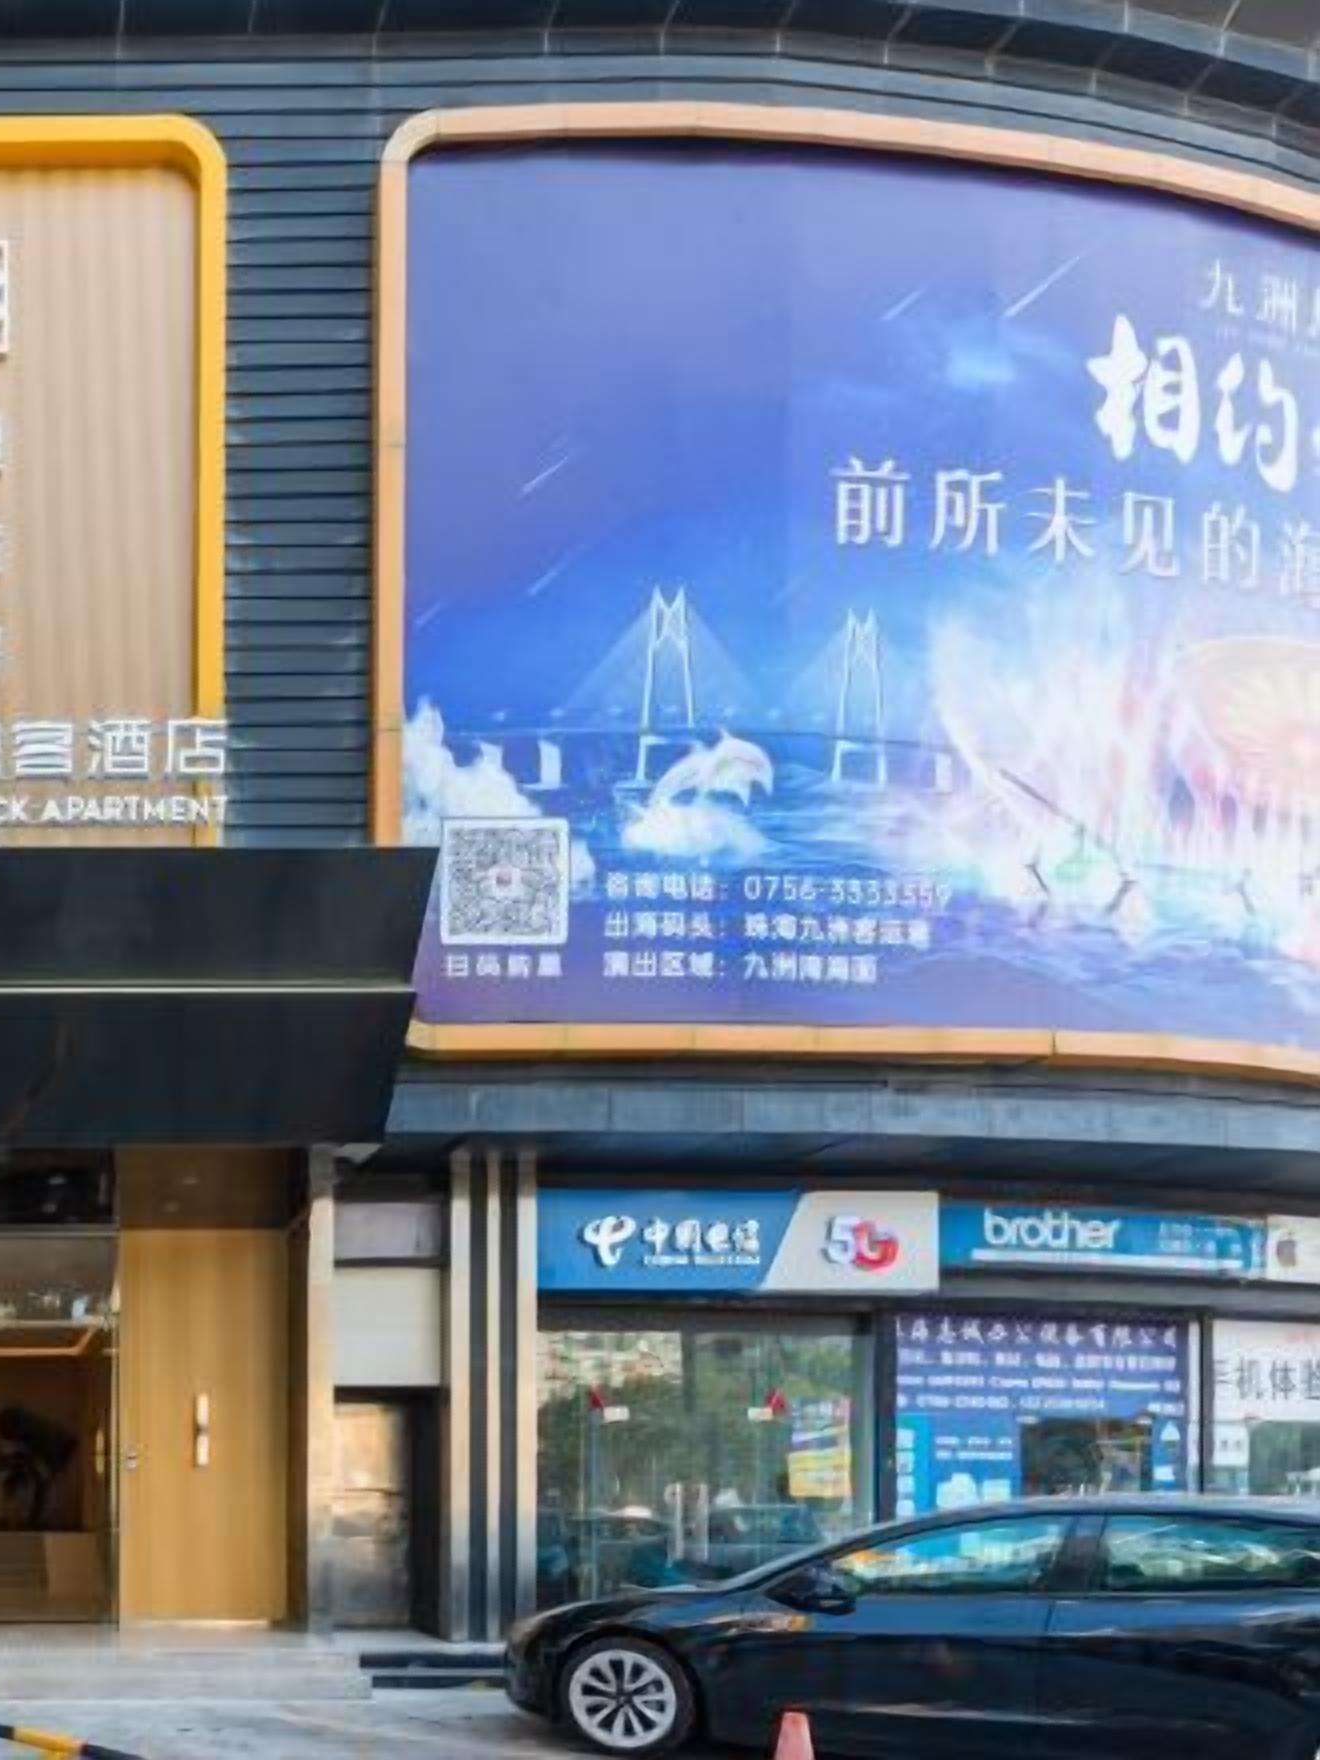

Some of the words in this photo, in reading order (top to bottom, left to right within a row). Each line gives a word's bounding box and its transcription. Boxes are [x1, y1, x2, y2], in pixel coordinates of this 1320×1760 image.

[1197, 259, 1320, 338] 九洲
[1087, 314, 1320, 492] 相约
[41, 797, 228, 823] APARTMENT
[983, 1206, 1120, 1249] brother
